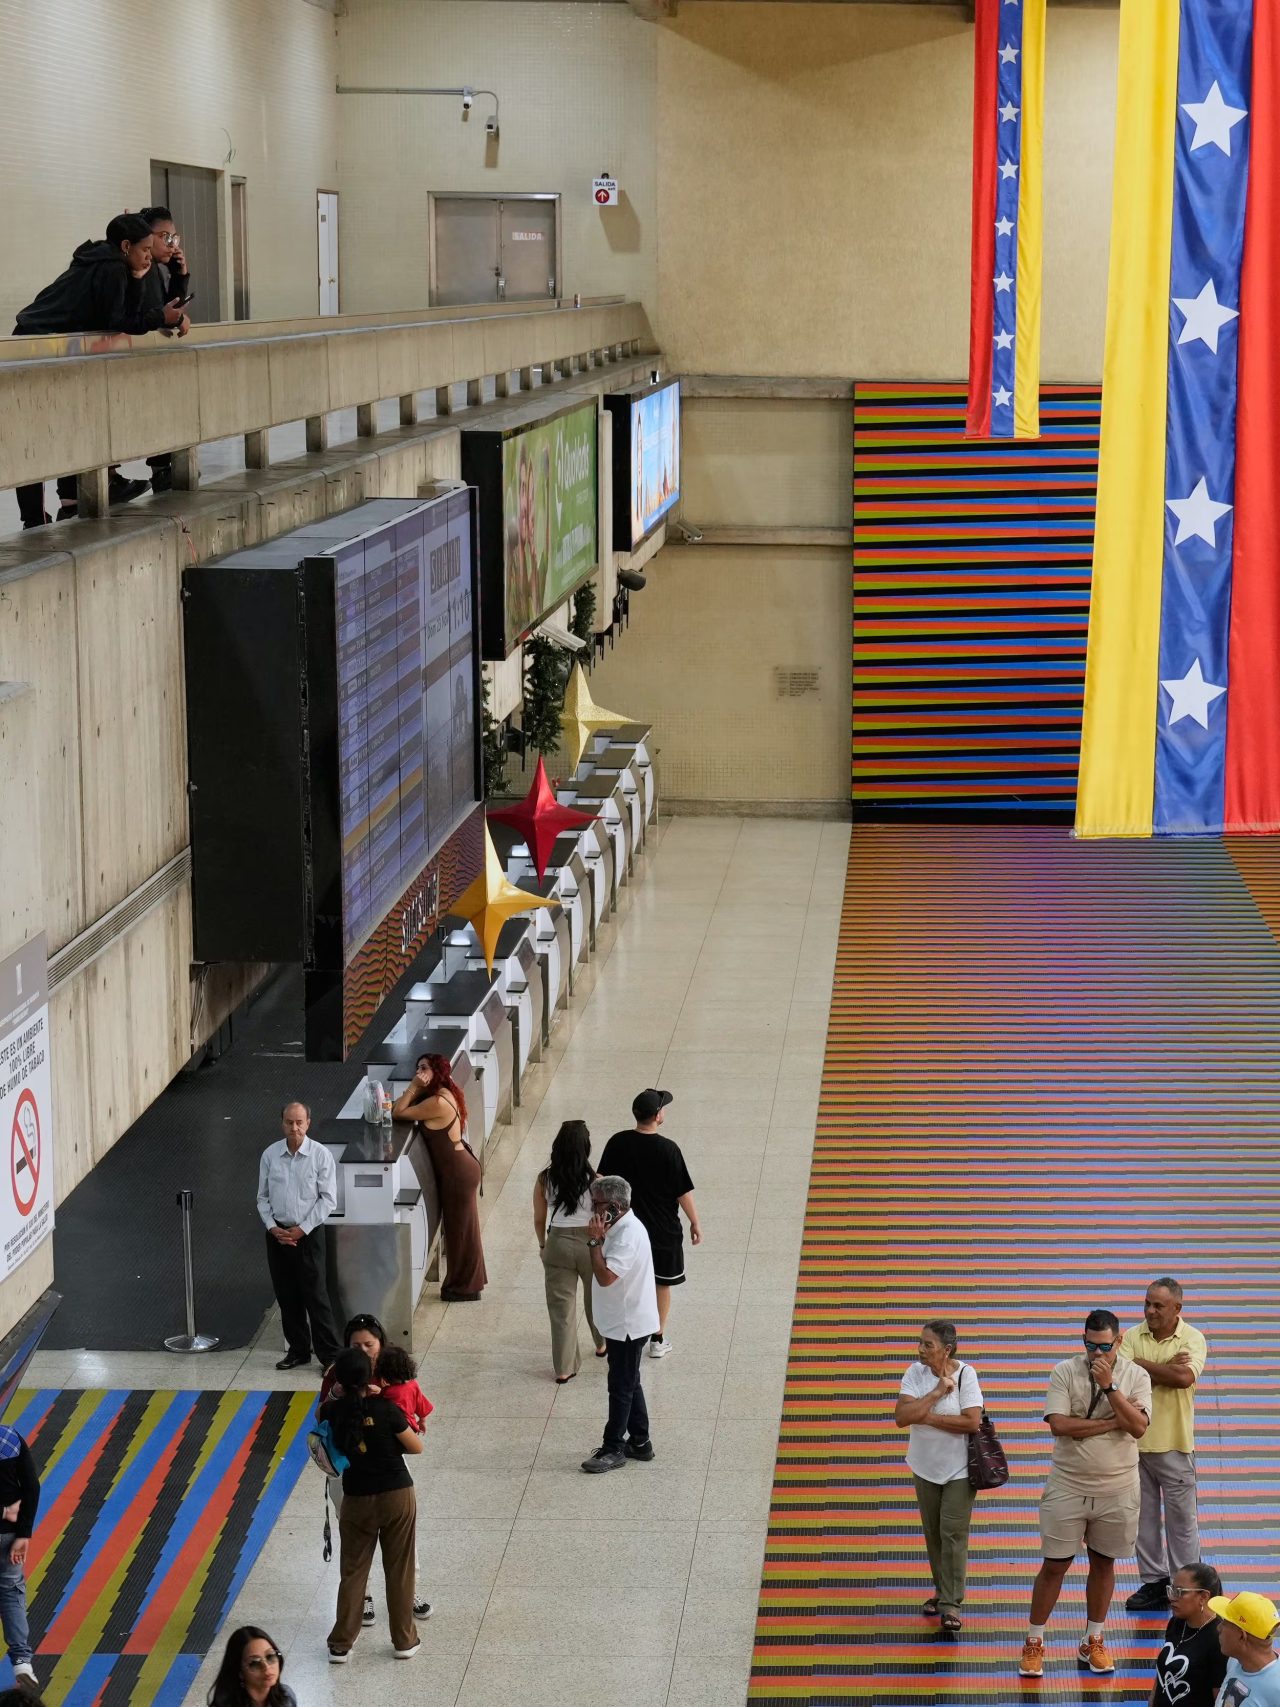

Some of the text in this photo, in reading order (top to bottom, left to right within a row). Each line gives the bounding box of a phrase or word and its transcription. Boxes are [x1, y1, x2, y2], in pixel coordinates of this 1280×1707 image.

[513, 231, 542, 241] SALIDA
[10, 1041, 16, 1056] ES
[23, 1017, 43, 1044] AMBIENTE
[7, 1071, 20, 1093] HUMO
[22, 1065, 28, 1081] DE
[29, 1049, 44, 1074] TABACO
[9, 1041, 35, 1074] 100% LIBRE
